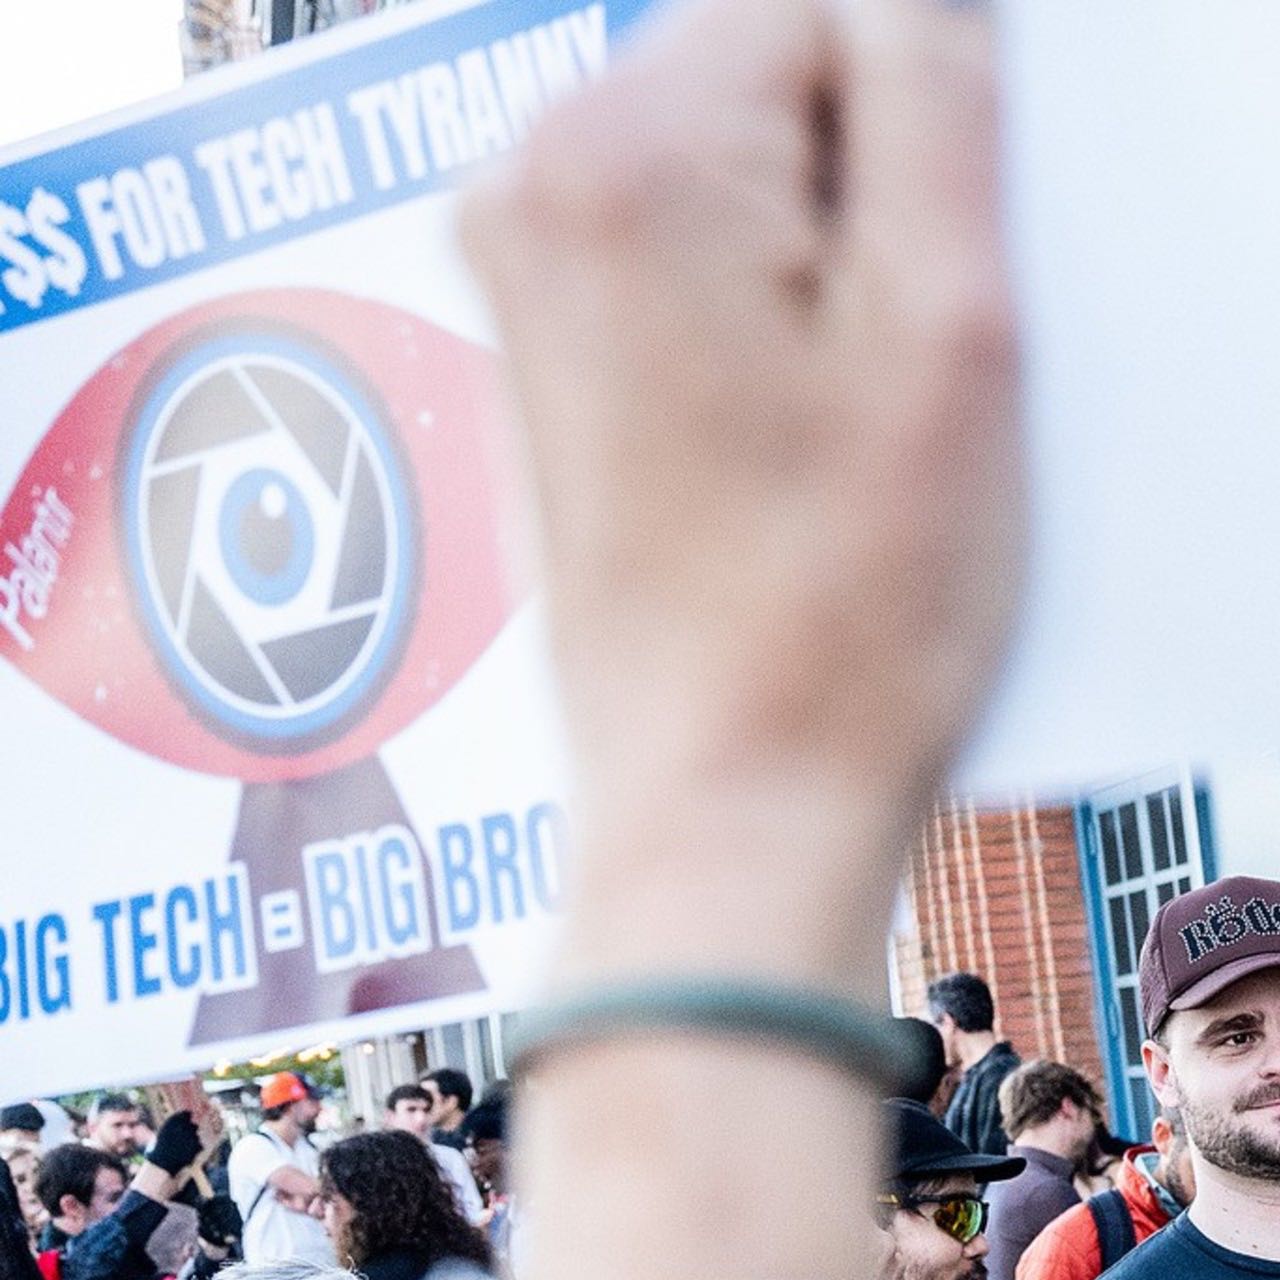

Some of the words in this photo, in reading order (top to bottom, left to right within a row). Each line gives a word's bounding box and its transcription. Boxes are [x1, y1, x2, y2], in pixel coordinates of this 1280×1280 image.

[76, 160, 205, 280] FOR
[193, 103, 355, 241] TECH
[93, 875, 247, 1003] TECH
[314, 837, 419, 960] BIG
[437, 801, 571, 933] BRO
